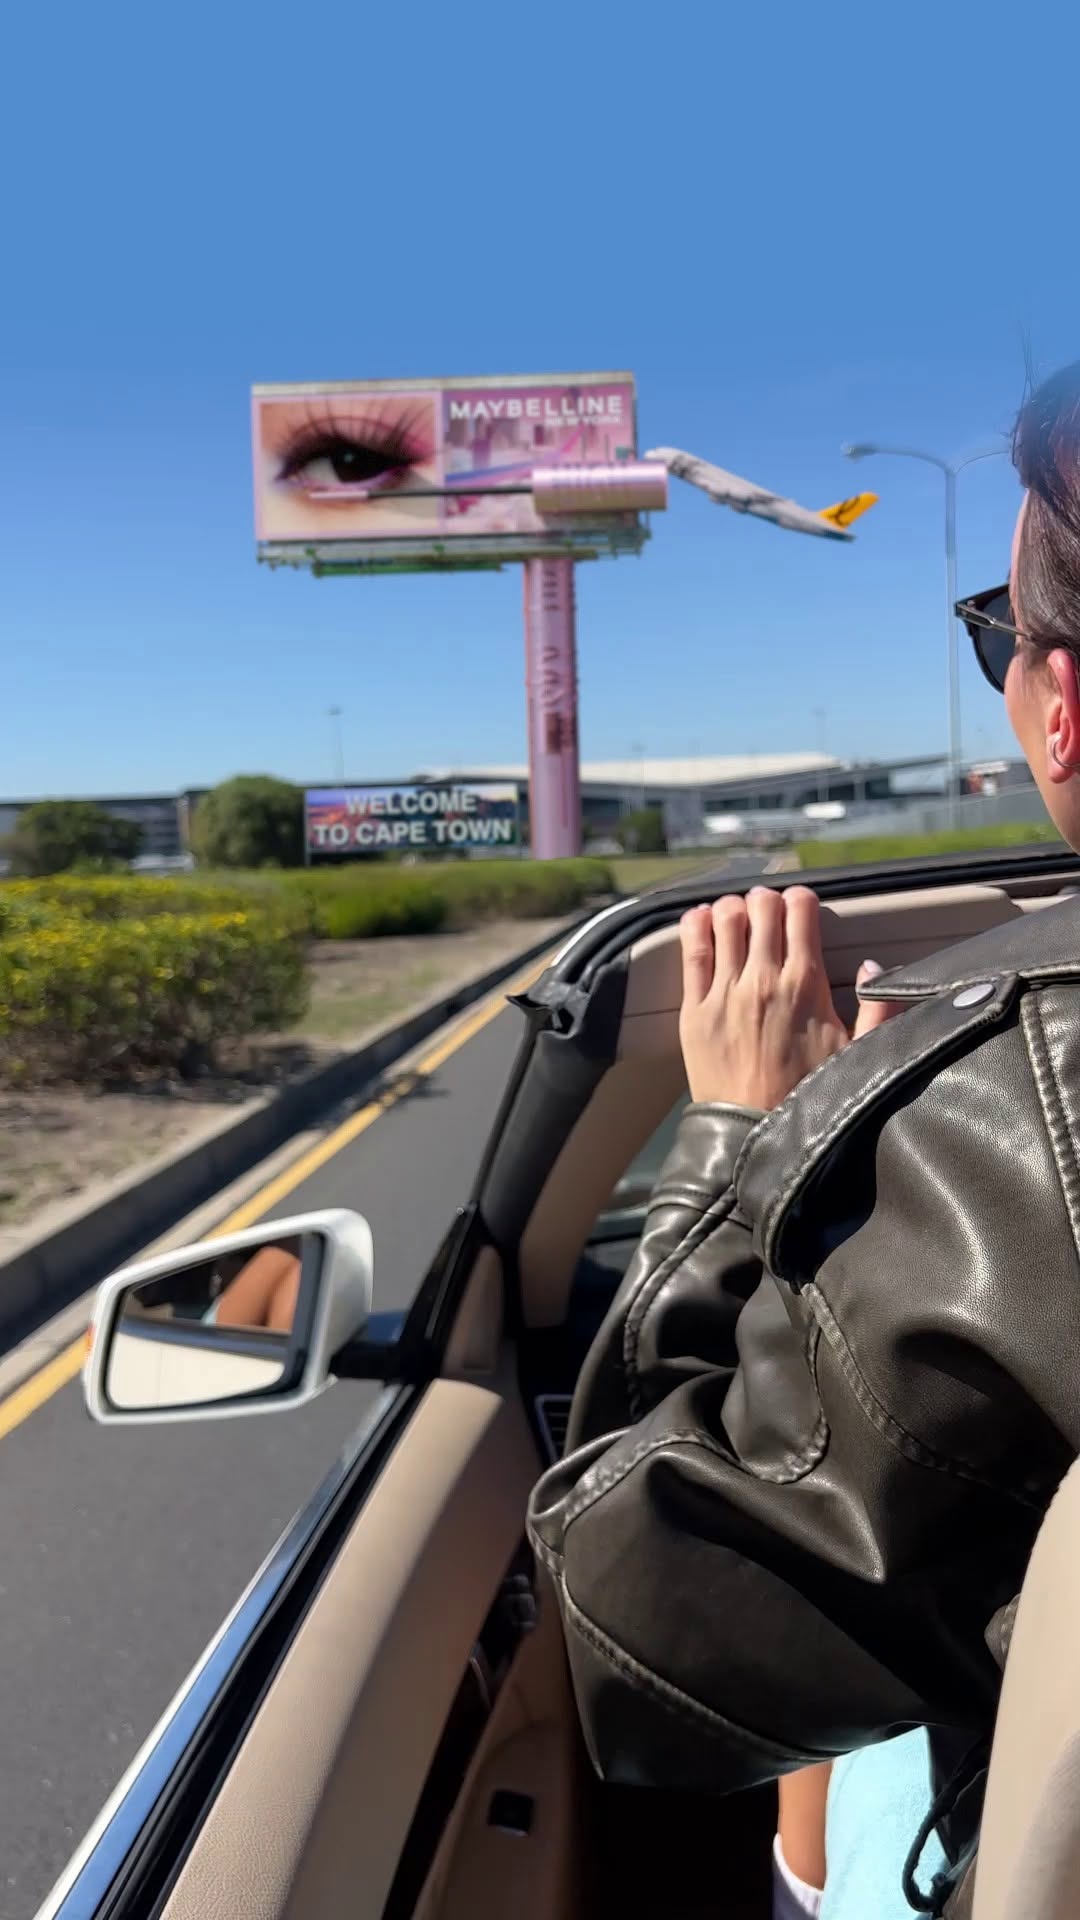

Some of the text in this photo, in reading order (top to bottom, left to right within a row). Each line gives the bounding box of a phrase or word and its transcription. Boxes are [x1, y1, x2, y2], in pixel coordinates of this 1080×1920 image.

[450, 395, 623, 419] MAYBELLINE
[347, 790, 477, 815] WELCOME
[313, 818, 512, 845] TO CAPE TOWN
